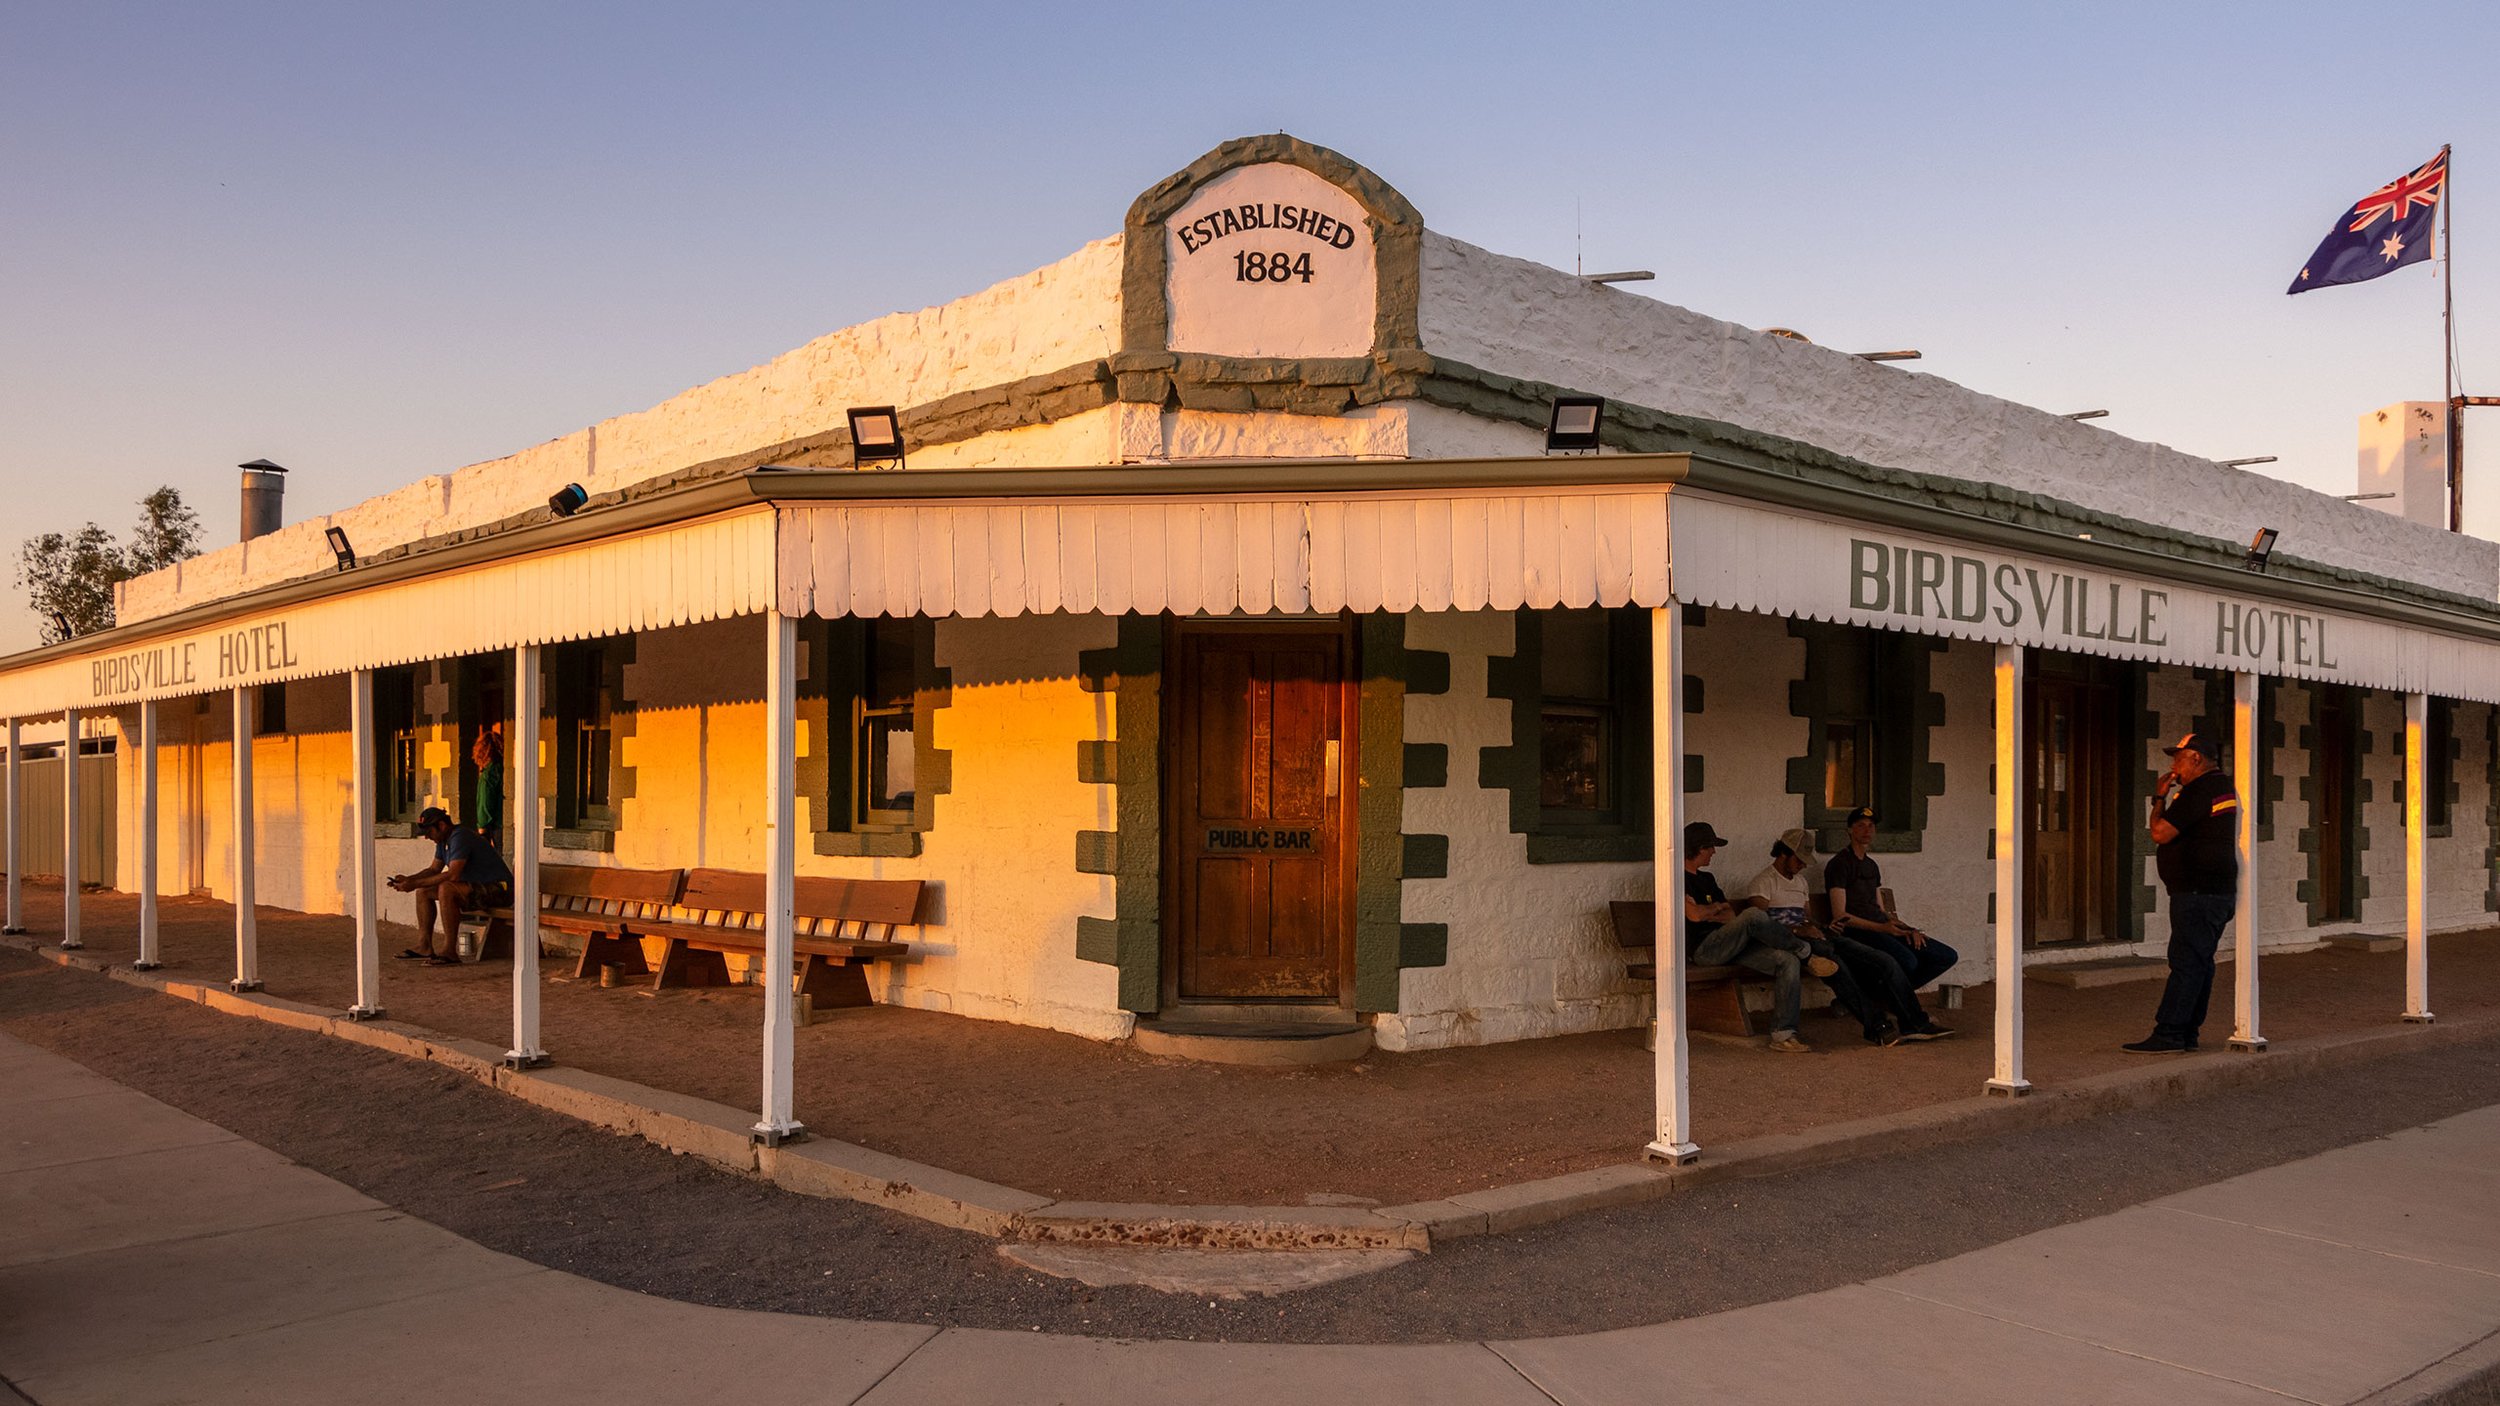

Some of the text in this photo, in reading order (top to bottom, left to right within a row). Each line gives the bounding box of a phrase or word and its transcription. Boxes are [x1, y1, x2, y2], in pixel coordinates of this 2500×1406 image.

[1177, 203, 1355, 255] ESTABLISHED
[1233, 250, 1315, 283] 1884
[1850, 538, 2338, 670] BIRDSVILLE HOTEL
[92, 621, 298, 697] BIRDSVILLE HOTEL
[1208, 830, 1311, 849] PUBLIC BAR
